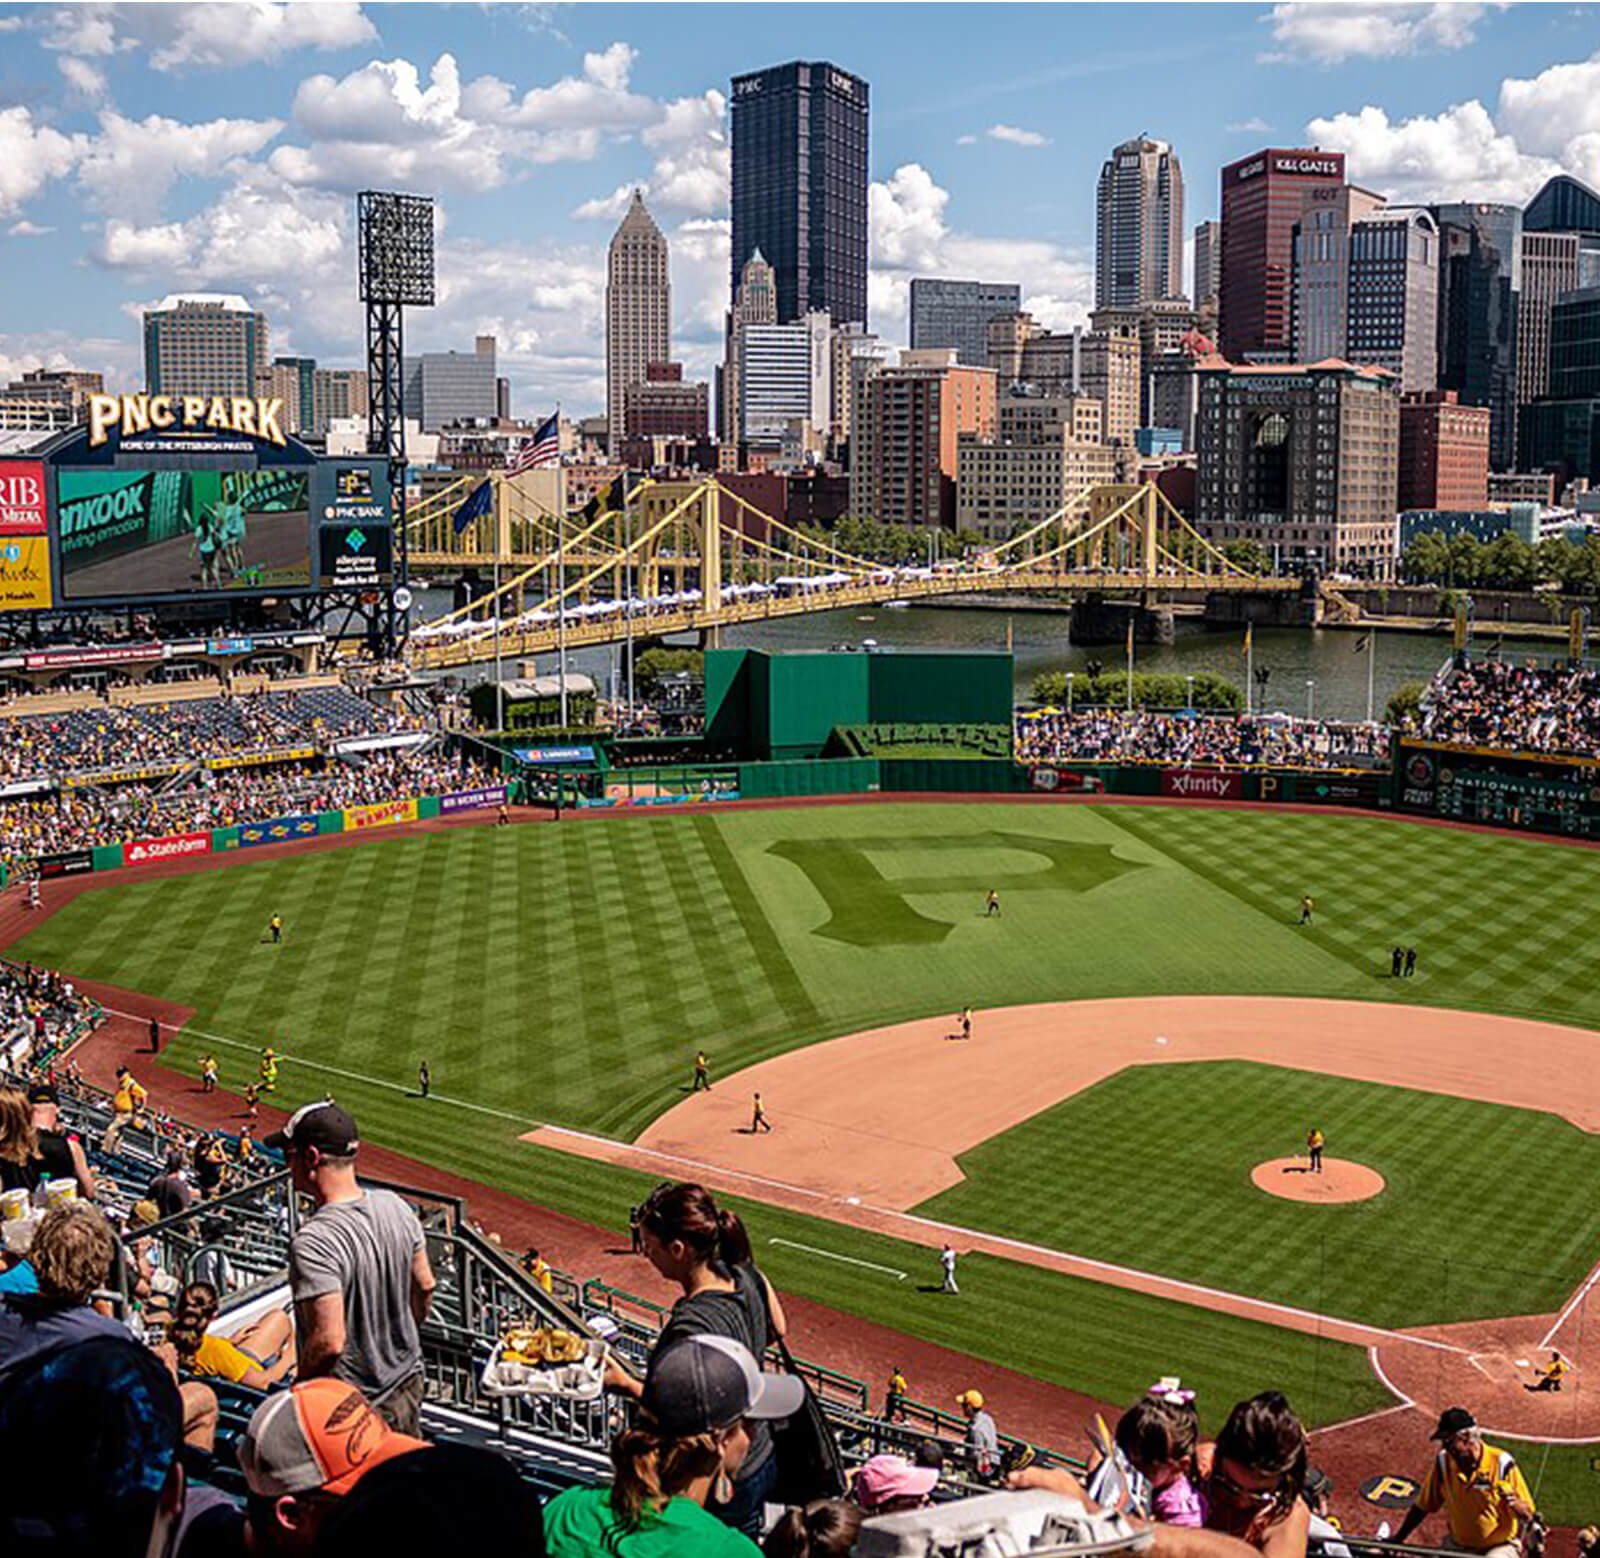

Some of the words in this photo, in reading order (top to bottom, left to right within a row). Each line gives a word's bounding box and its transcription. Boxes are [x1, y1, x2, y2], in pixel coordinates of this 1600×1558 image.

[1299, 160, 1337, 173] GATES
[88, 391, 176, 447] PNC
[181, 395, 287, 447] PARK
[1172, 774, 1231, 796] xfinity
[1260, 777, 1277, 799] P
[1454, 777, 1525, 795] NATIONAL
[1531, 786, 1587, 801] LEAGUE
[1366, 1476, 1415, 1501] P
